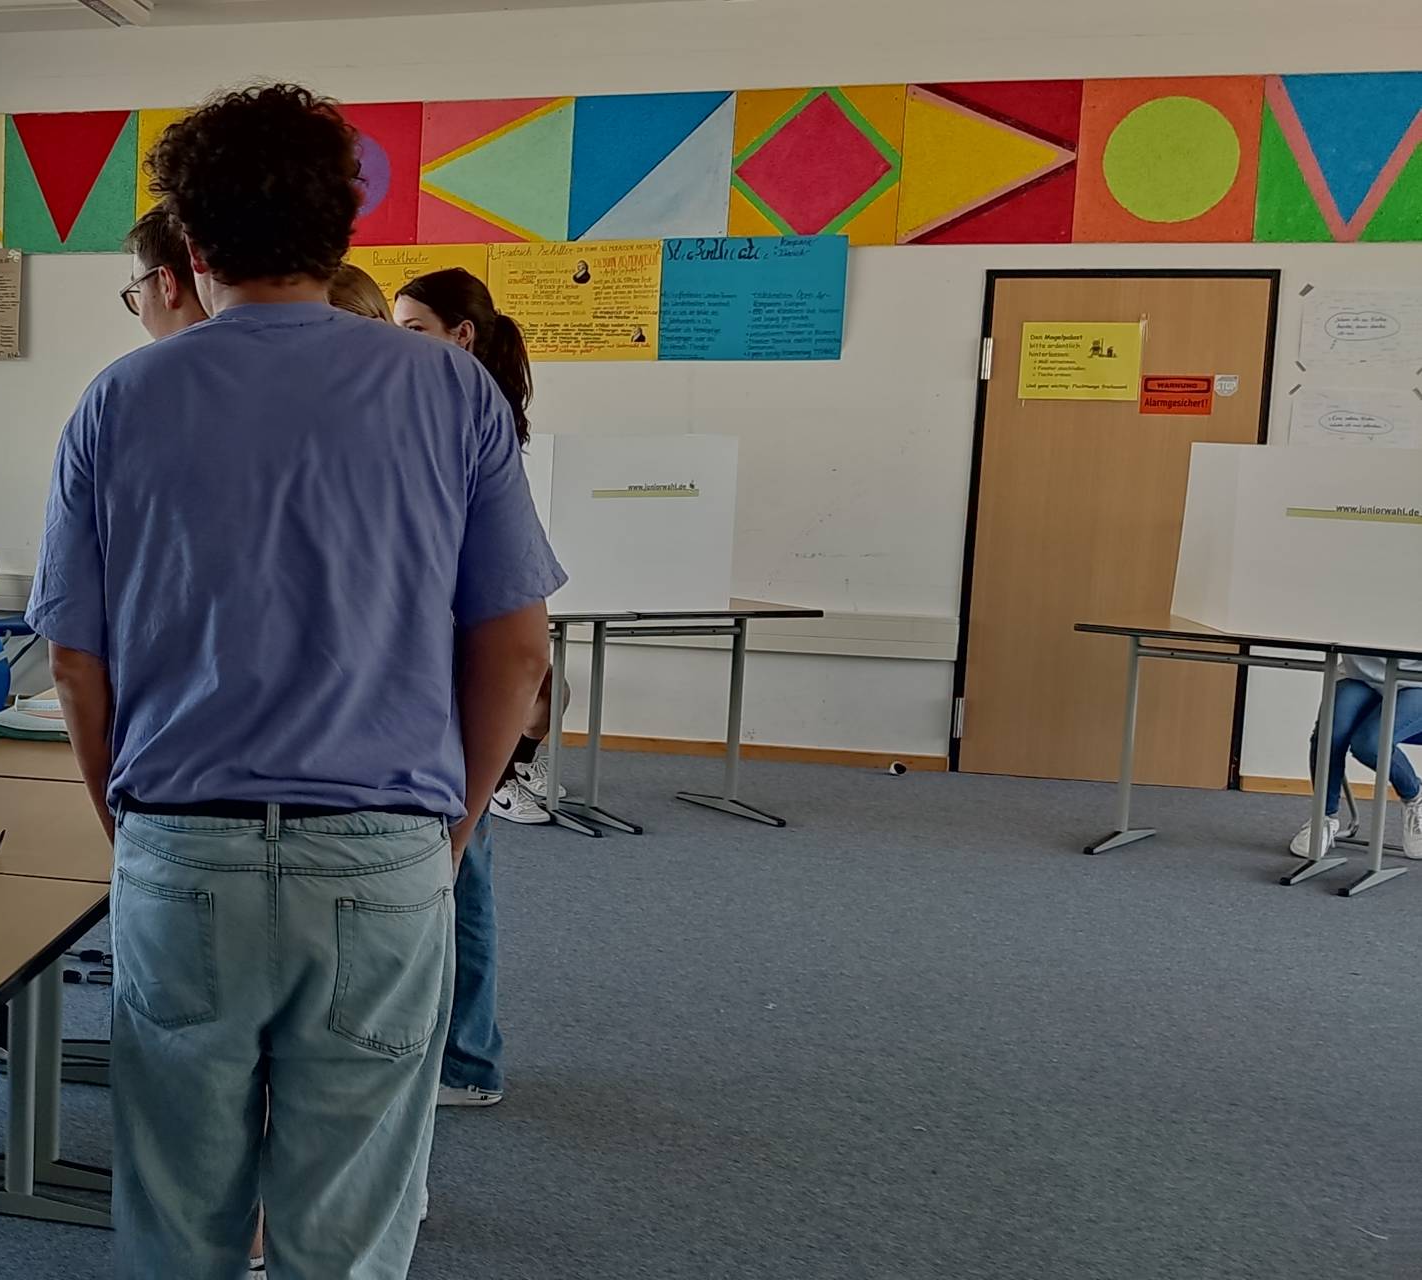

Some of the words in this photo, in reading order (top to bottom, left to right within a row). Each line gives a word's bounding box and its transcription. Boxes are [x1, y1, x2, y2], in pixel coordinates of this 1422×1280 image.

[1144, 397, 1209, 410] Alarmgesichert!
[628, 483, 687, 491] www.juniorwahl.de
[1336, 504, 1419, 517] www.juniorwahl.de
